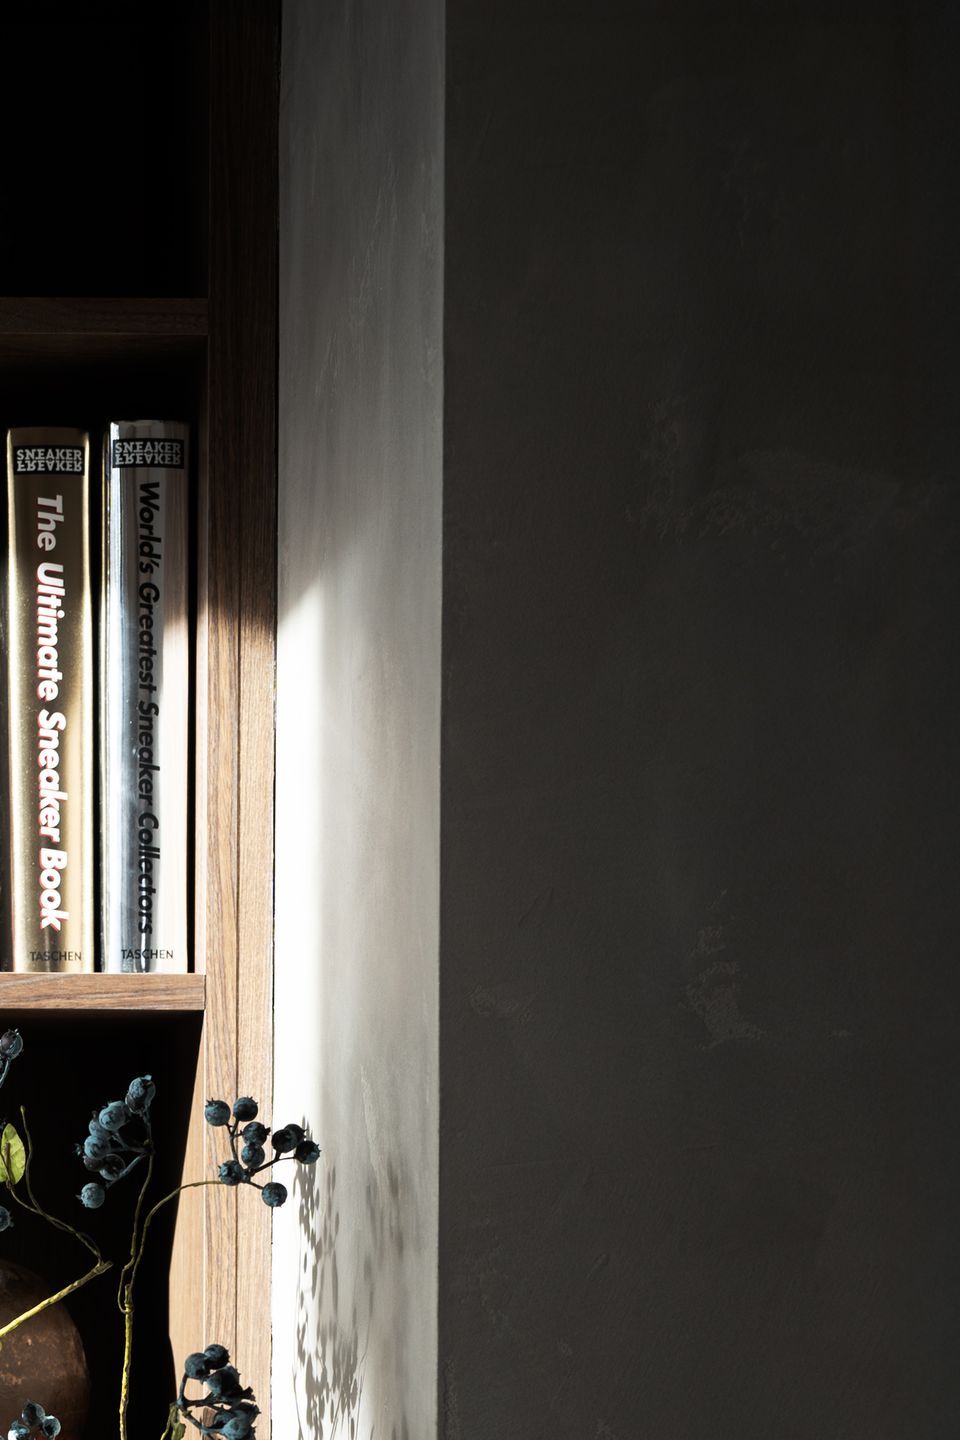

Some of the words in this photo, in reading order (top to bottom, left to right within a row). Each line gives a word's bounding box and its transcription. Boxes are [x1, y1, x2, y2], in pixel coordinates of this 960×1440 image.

[16, 448, 83, 460] SNEAKER
[115, 441, 182, 453] SNEAKER
[38, 494, 65, 551] The
[139, 481, 162, 574] World's
[37, 562, 66, 702] Ultimate
[138, 582, 160, 694] Greatest
[38, 708, 69, 843] Sneaker
[138, 700, 161, 807] Sneaker
[39, 847, 70, 932] Book
[138, 812, 161, 934] Collectors
[30, 951, 82, 962] TASCHEN
[121, 949, 174, 960] TASCHEN
